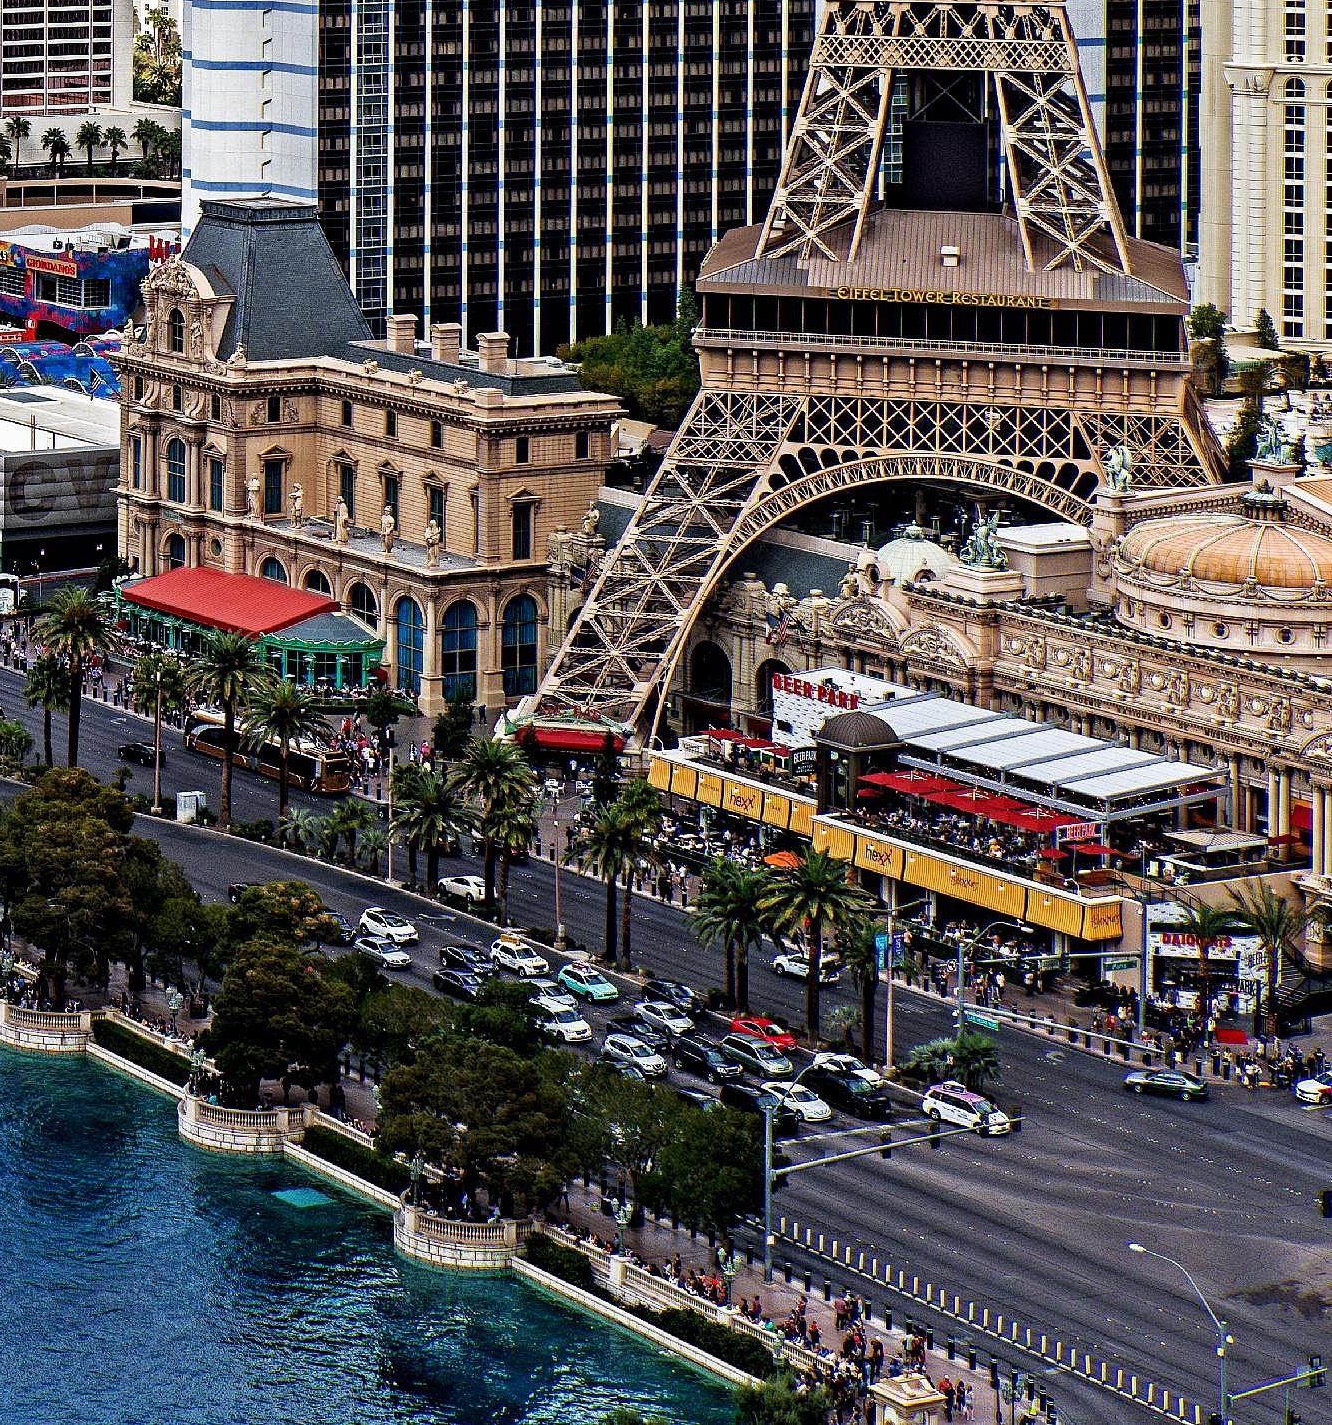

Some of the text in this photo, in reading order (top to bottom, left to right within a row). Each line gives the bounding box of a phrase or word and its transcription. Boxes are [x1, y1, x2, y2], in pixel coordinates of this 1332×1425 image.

[27, 258, 76, 276] GIORDANO'S
[837, 286, 1045, 308] EIFFEL TOWER RESTAURANT
[773, 673, 859, 710] BEER PARK
[865, 844, 891, 866] hexx
